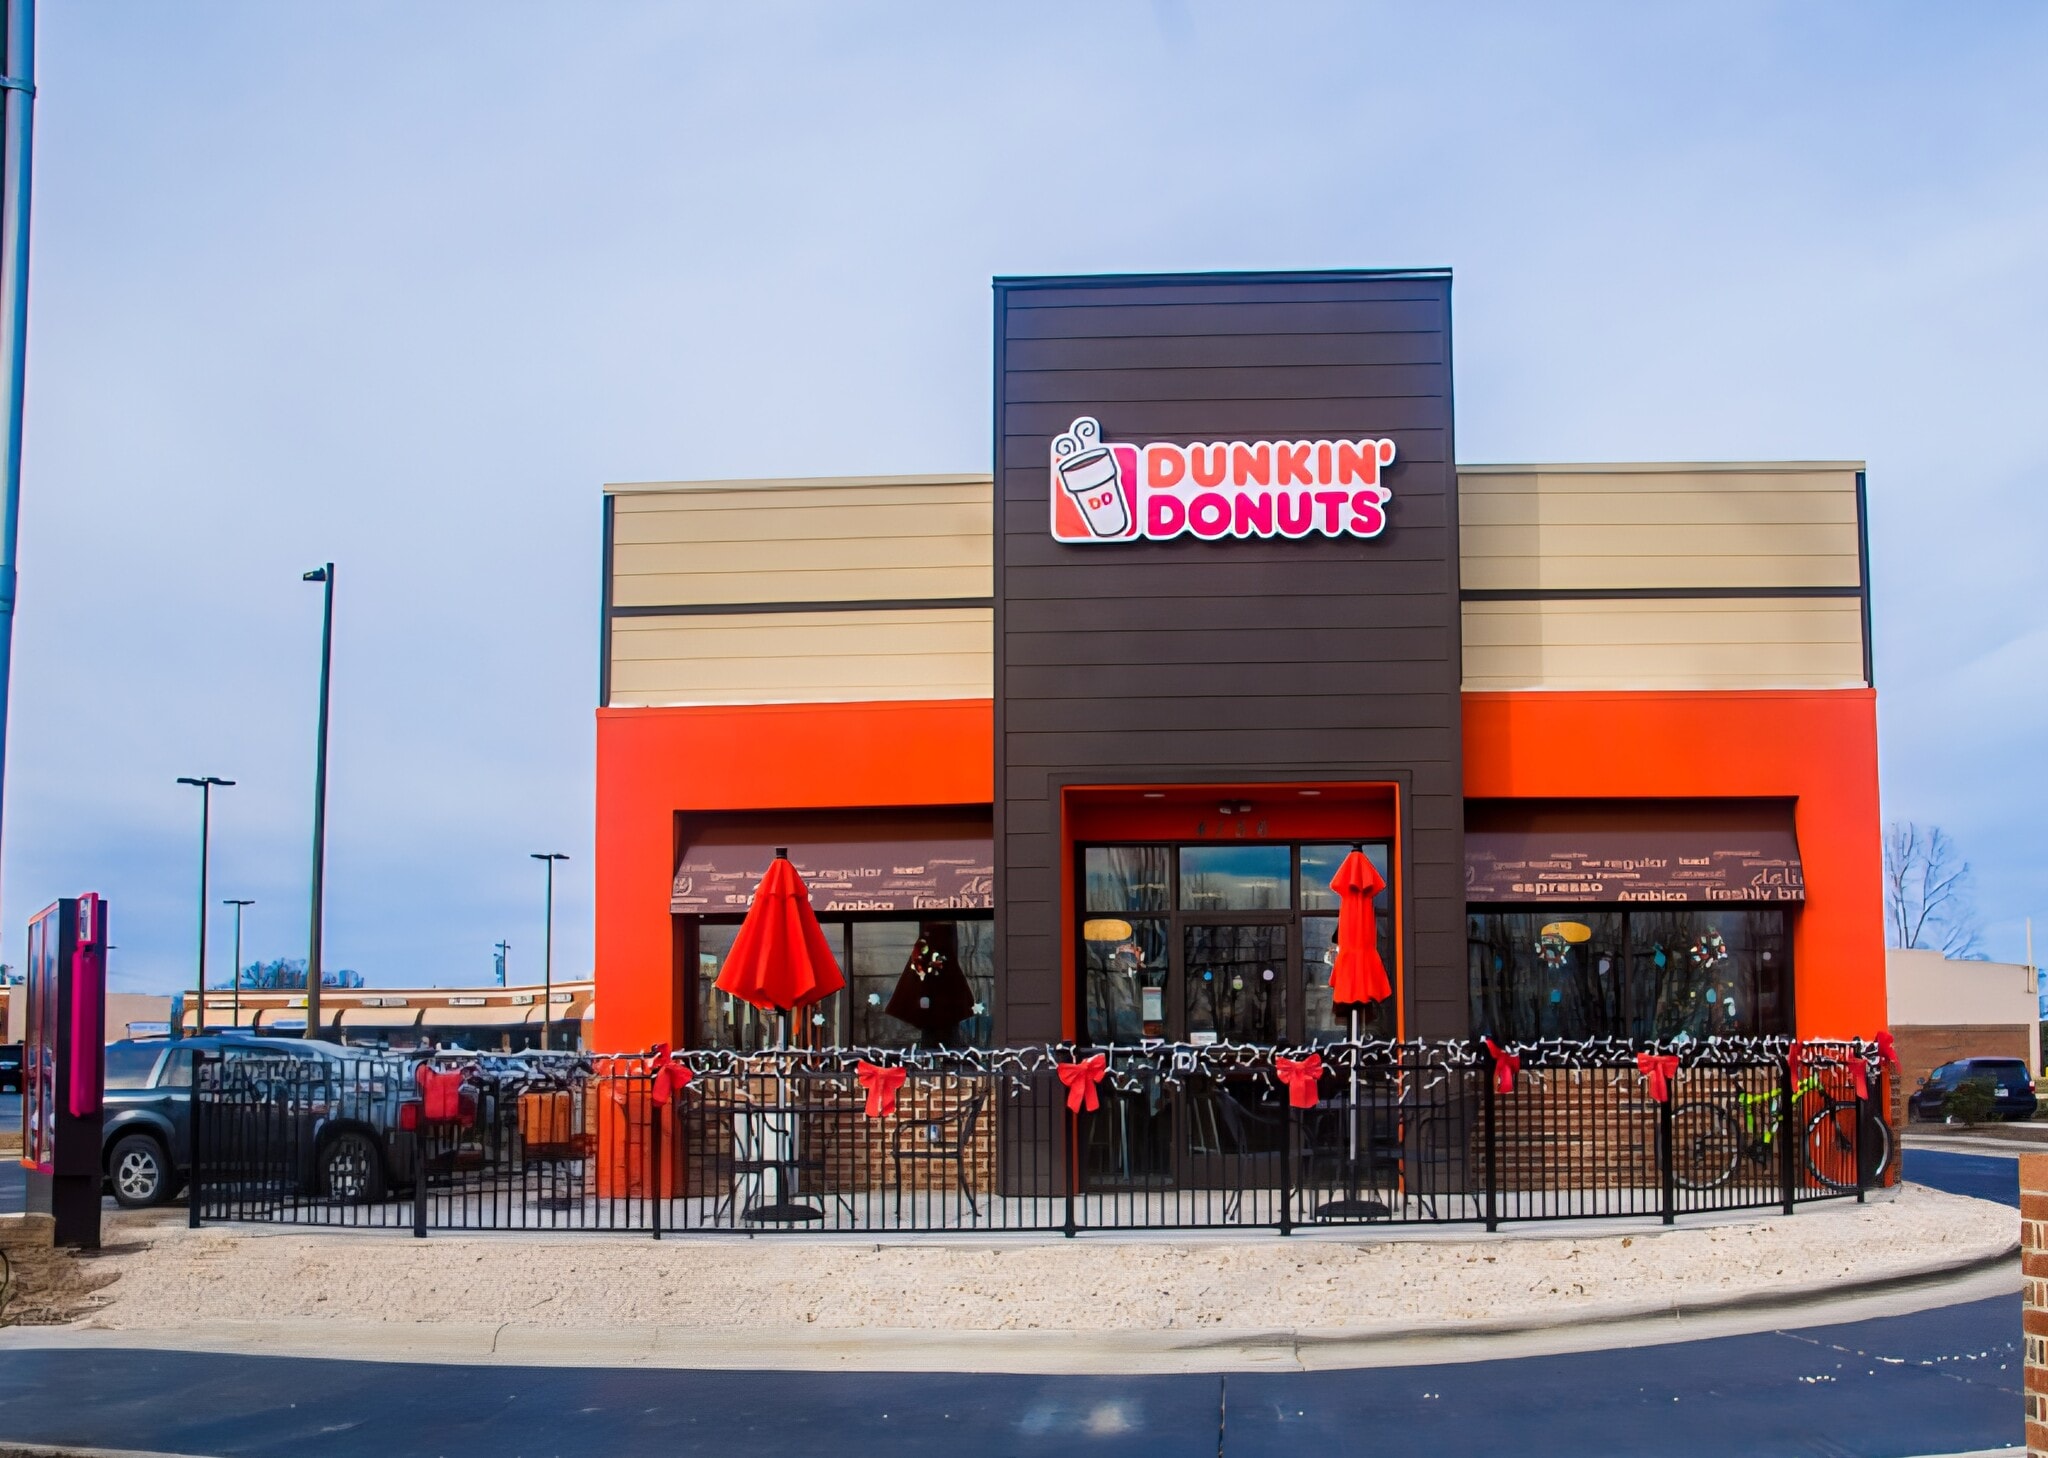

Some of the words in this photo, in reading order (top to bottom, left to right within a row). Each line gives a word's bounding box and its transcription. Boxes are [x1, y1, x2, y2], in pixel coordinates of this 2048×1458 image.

[1147, 442, 1392, 488] DUNKIN'
[1147, 491, 1382, 536] DONUTS
[818, 867, 882, 880] regular
[1603, 857, 1667, 870] regular
